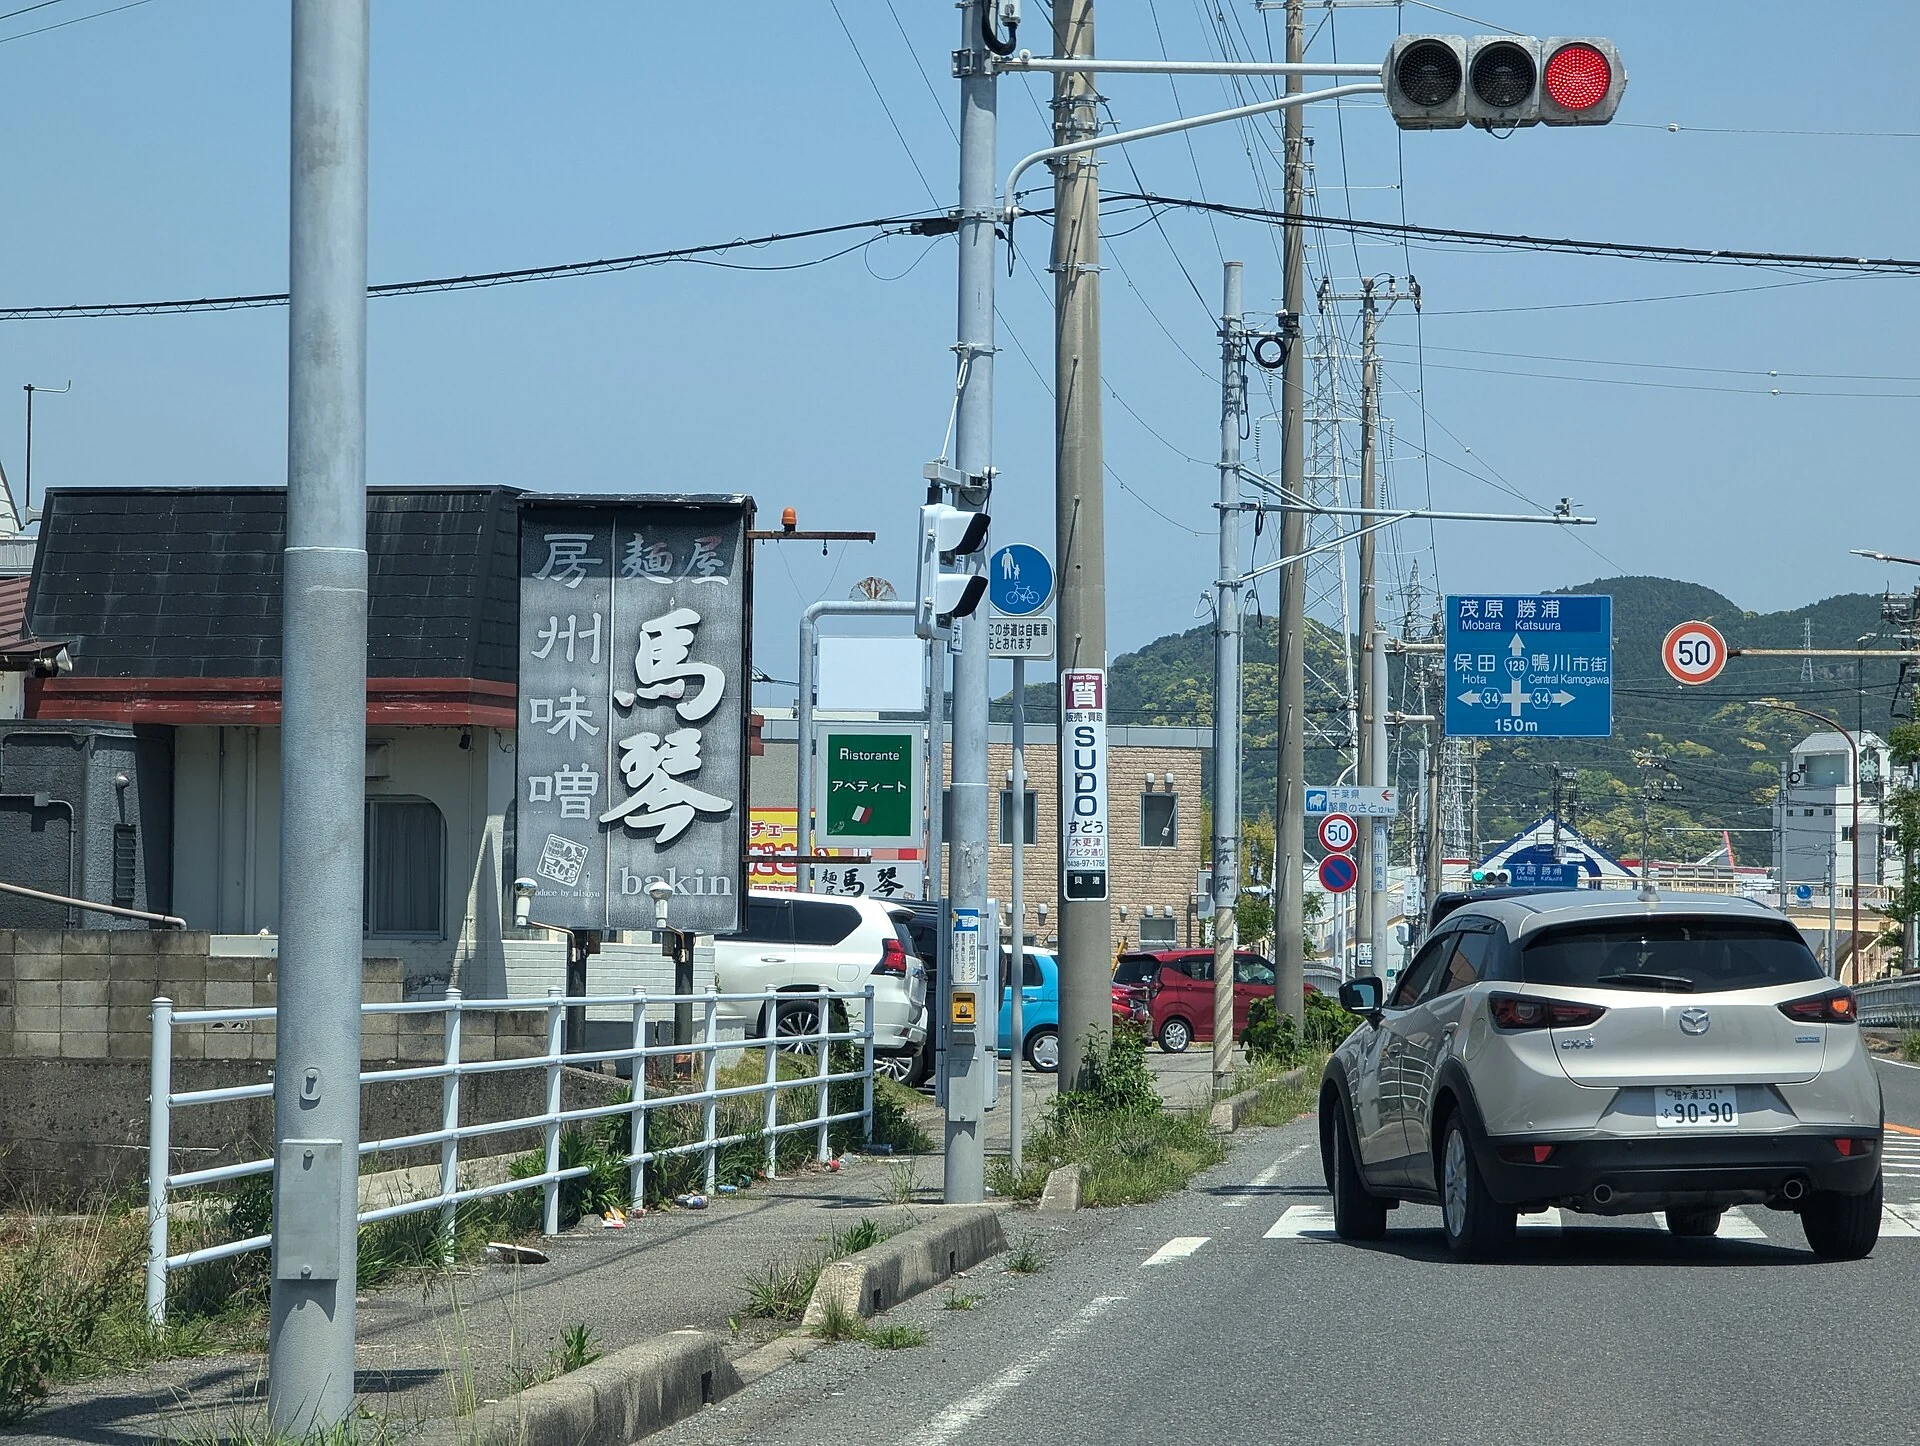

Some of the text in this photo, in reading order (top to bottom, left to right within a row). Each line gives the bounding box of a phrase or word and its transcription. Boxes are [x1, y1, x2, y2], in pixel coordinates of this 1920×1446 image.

[1459, 600, 1561, 618] 茂原 勝浦
[989, 623, 1048, 637] この歩道は自転車
[1462, 620, 1562, 631] Mobara Katsuura
[1678, 640, 1711, 666] 50
[1453, 653, 1496, 672] 保田
[1508, 660, 1525, 671] 128
[1531, 653, 1608, 672] 鴨川市街
[528, 533, 602, 820] 房州味噌
[1462, 674, 1487, 684] Hota
[1528, 674, 1610, 687] Central Kamogawa
[1072, 682, 1097, 708] 質
[1484, 692, 1499, 705] 34
[1534, 692, 1549, 705] 34
[599, 607, 734, 845] 馬琴
[1494, 719, 1538, 732] 150m
[840, 748, 900, 761] Ristorante
[1074, 726, 1097, 816] SUDO
[832, 780, 907, 793] アペティート
[1331, 789, 1360, 799] 千葉県
[1068, 820, 1104, 834] すどう
[1327, 824, 1349, 842] 50
[1072, 837, 1102, 848] 木更津
[620, 867, 732, 896] bakin
[839, 866, 904, 897] 馬琴
[1661, 1102, 1734, 1124] ふ 90-90
